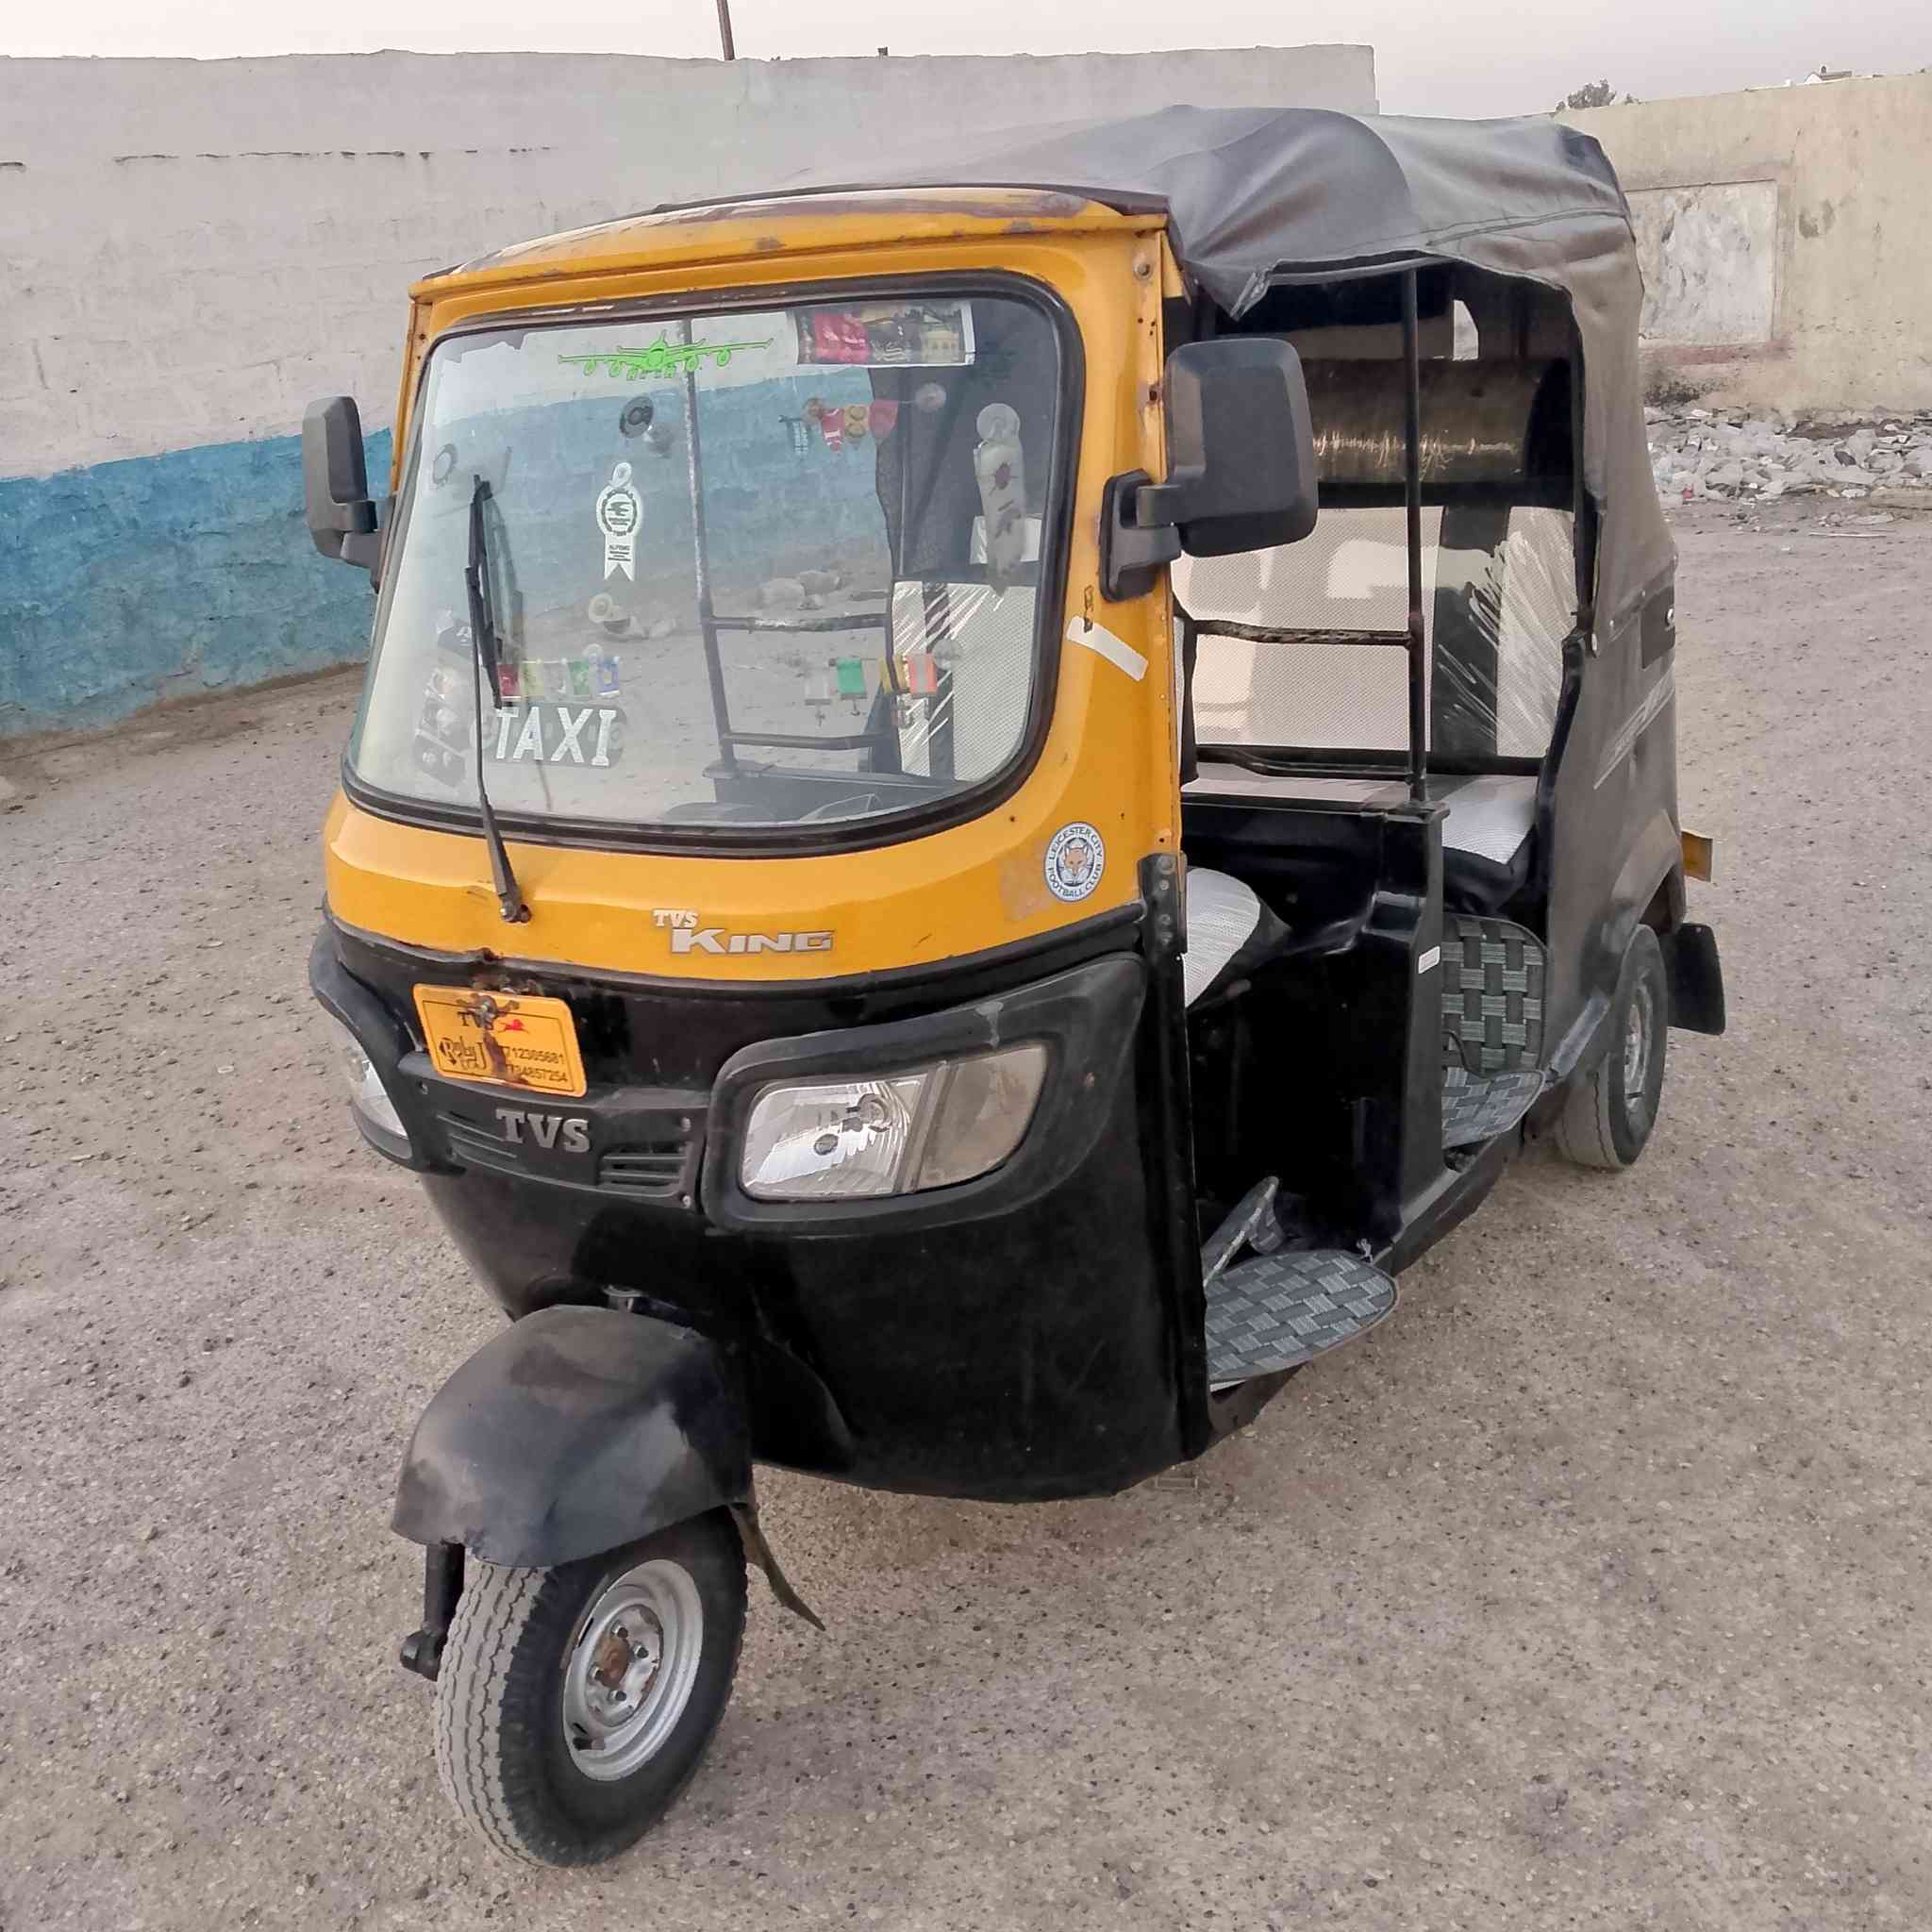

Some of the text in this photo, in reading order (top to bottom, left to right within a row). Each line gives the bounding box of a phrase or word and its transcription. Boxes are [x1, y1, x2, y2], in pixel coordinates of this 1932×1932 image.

[495, 706, 617, 766] TAXI
[1049, 827, 1103, 860] LEICESTER CITY
[1047, 863, 1102, 897] FOOTBALL CLUB
[653, 909, 699, 928] TVS
[495, 1108, 590, 1153] TVS
